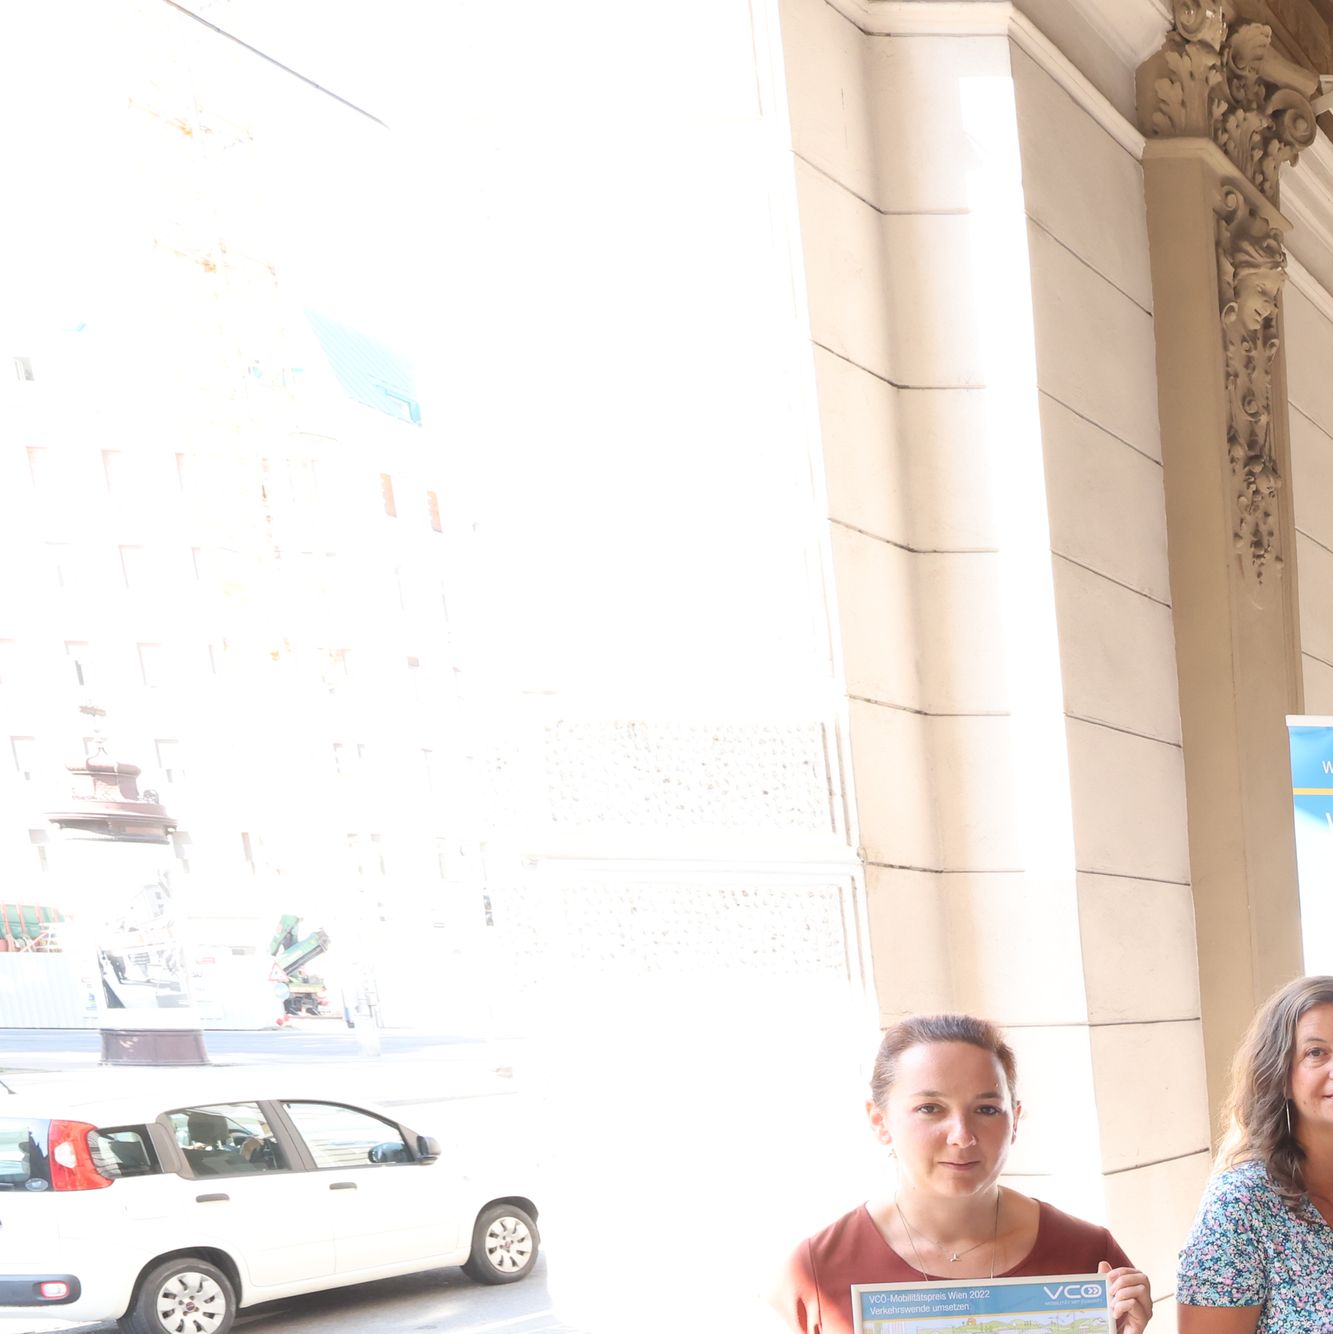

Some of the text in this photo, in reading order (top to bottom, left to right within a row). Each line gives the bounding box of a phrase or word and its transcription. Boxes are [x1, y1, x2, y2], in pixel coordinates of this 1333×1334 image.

[868, 1289, 990, 1304] VCÖ-Mobilitätspreis Wien 2022
[869, 1302, 969, 1315] Verkehrswende umsetzen
